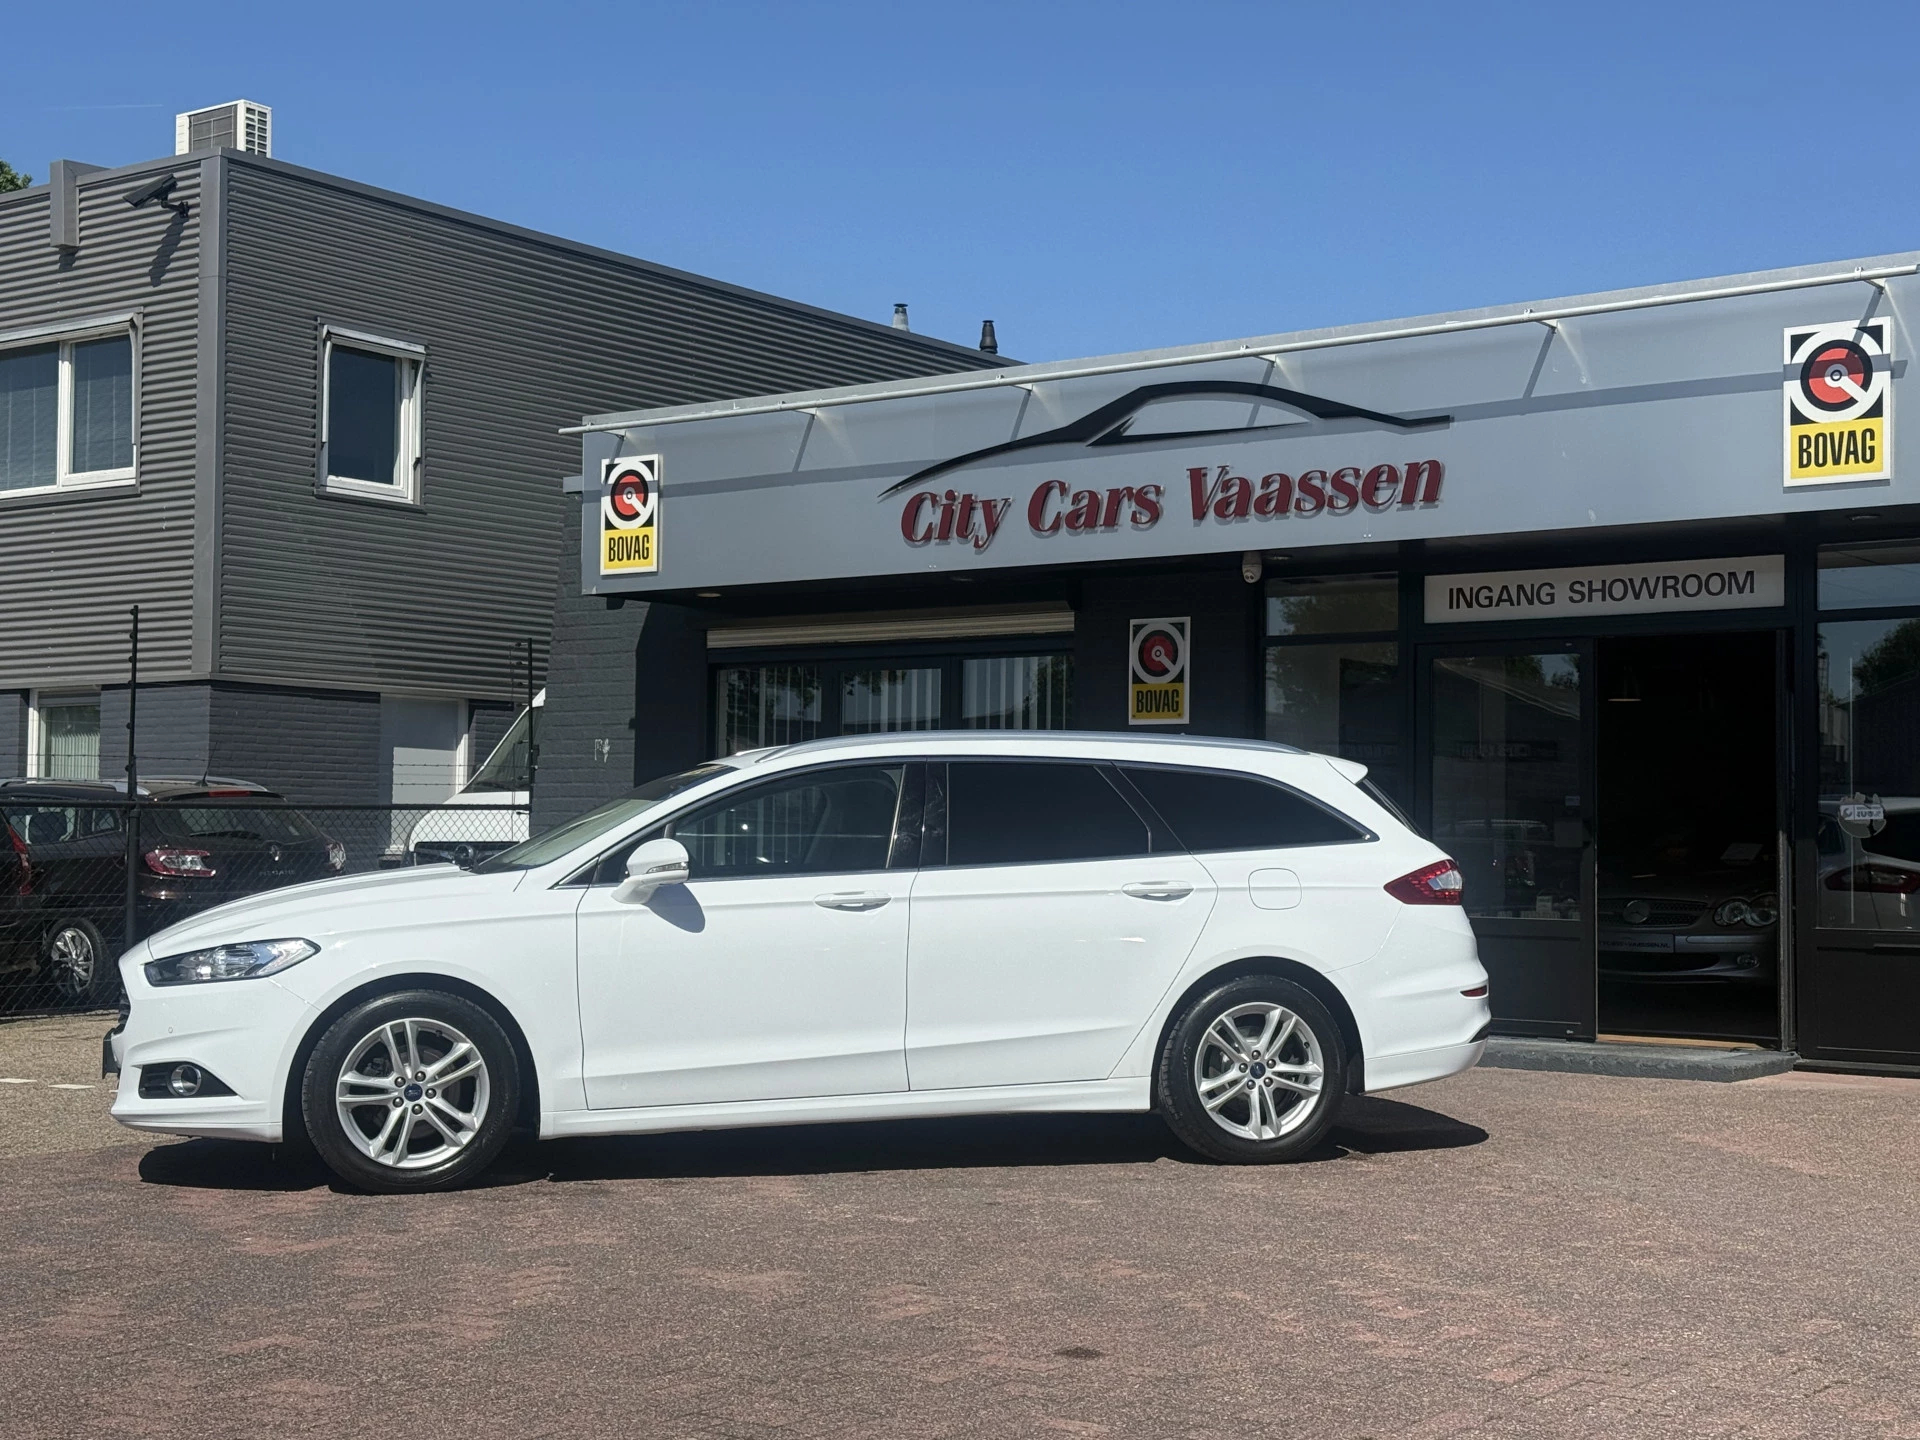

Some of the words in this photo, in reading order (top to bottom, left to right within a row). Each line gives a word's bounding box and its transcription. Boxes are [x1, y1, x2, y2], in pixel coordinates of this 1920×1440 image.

[1798, 428, 1876, 469] BOVAG
[900, 489, 1013, 551] City
[1027, 479, 1165, 532] Cars
[1186, 459, 1443, 521] Vaassen
[608, 534, 650, 562] BOVAG
[1449, 582, 1556, 610] INGANG
[1568, 570, 1755, 604] SHOWROOM
[1136, 689, 1180, 713] BOVAG
